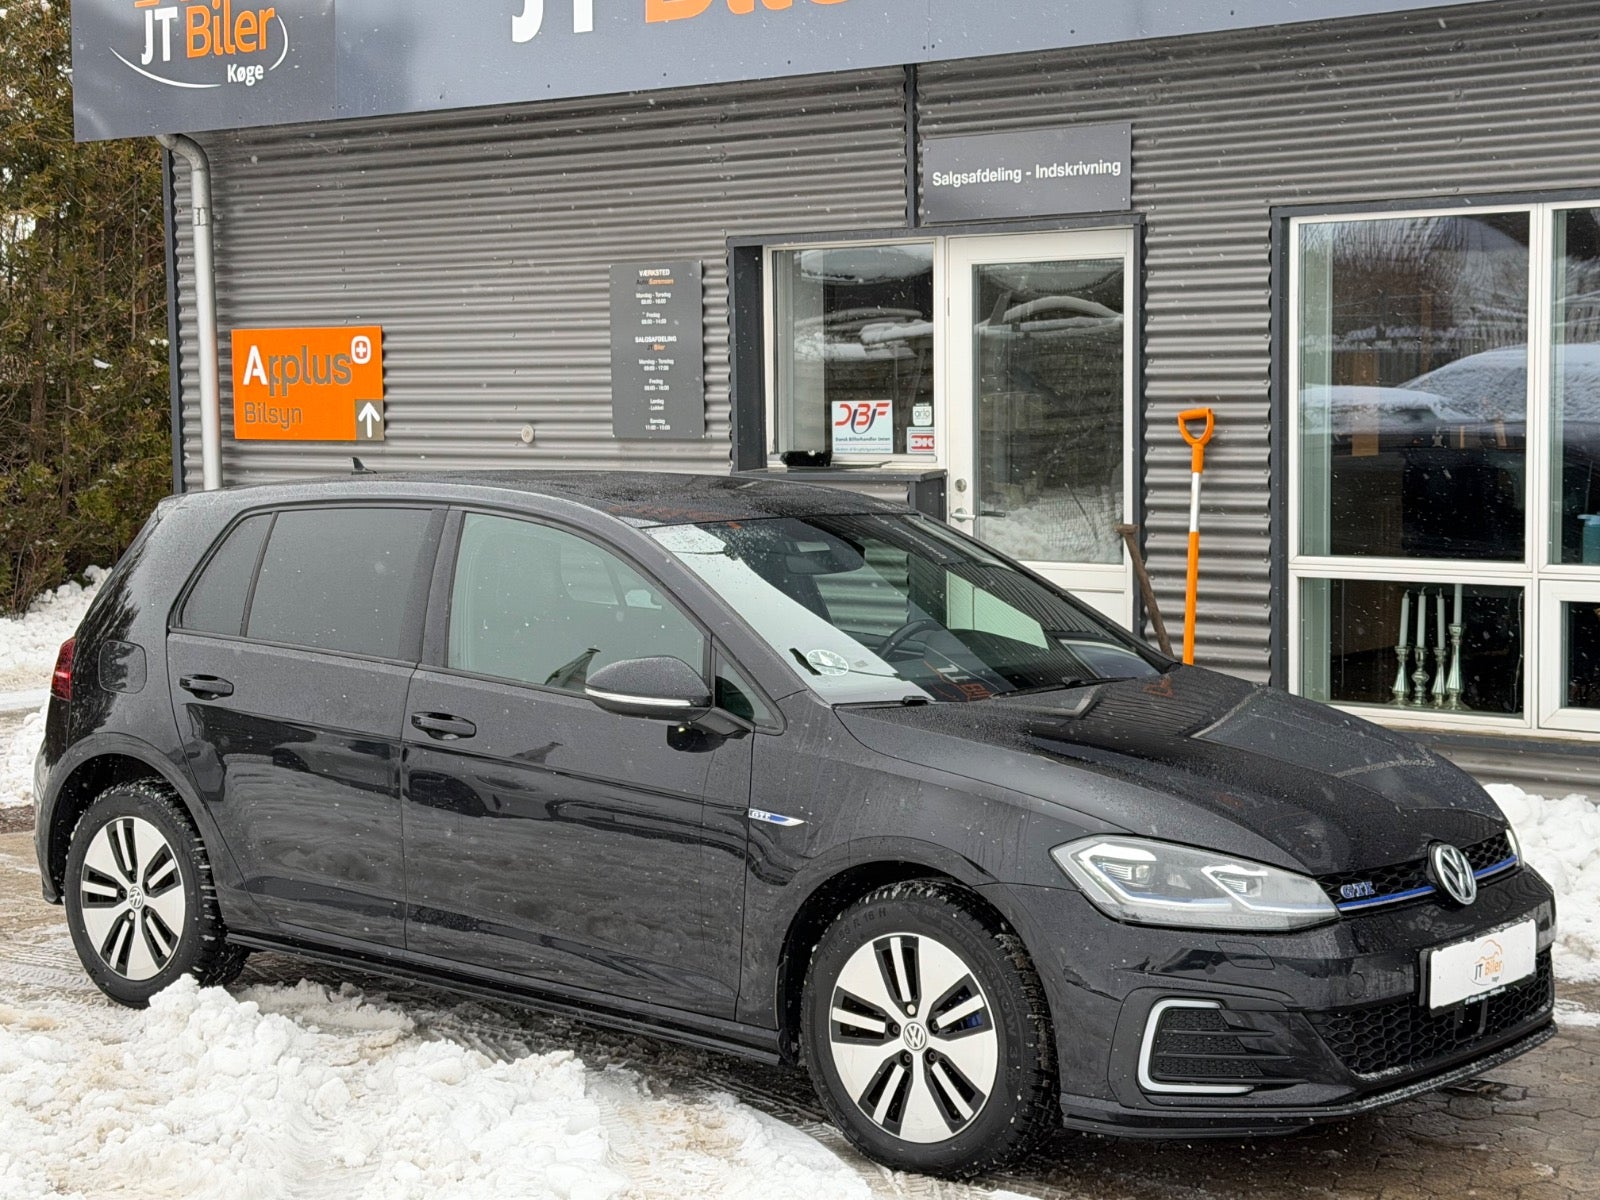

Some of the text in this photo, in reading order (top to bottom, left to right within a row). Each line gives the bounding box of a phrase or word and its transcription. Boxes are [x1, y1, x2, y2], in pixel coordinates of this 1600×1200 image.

[141, 0, 275, 65] JT Biler
[227, 64, 264, 86] Køge
[932, 168, 1022, 188] Salgsafdeling
[1035, 160, 1121, 179] Indskrivning
[639, 269, 671, 277] VÆRKSTED
[244, 402, 302, 430] Bilsyn
